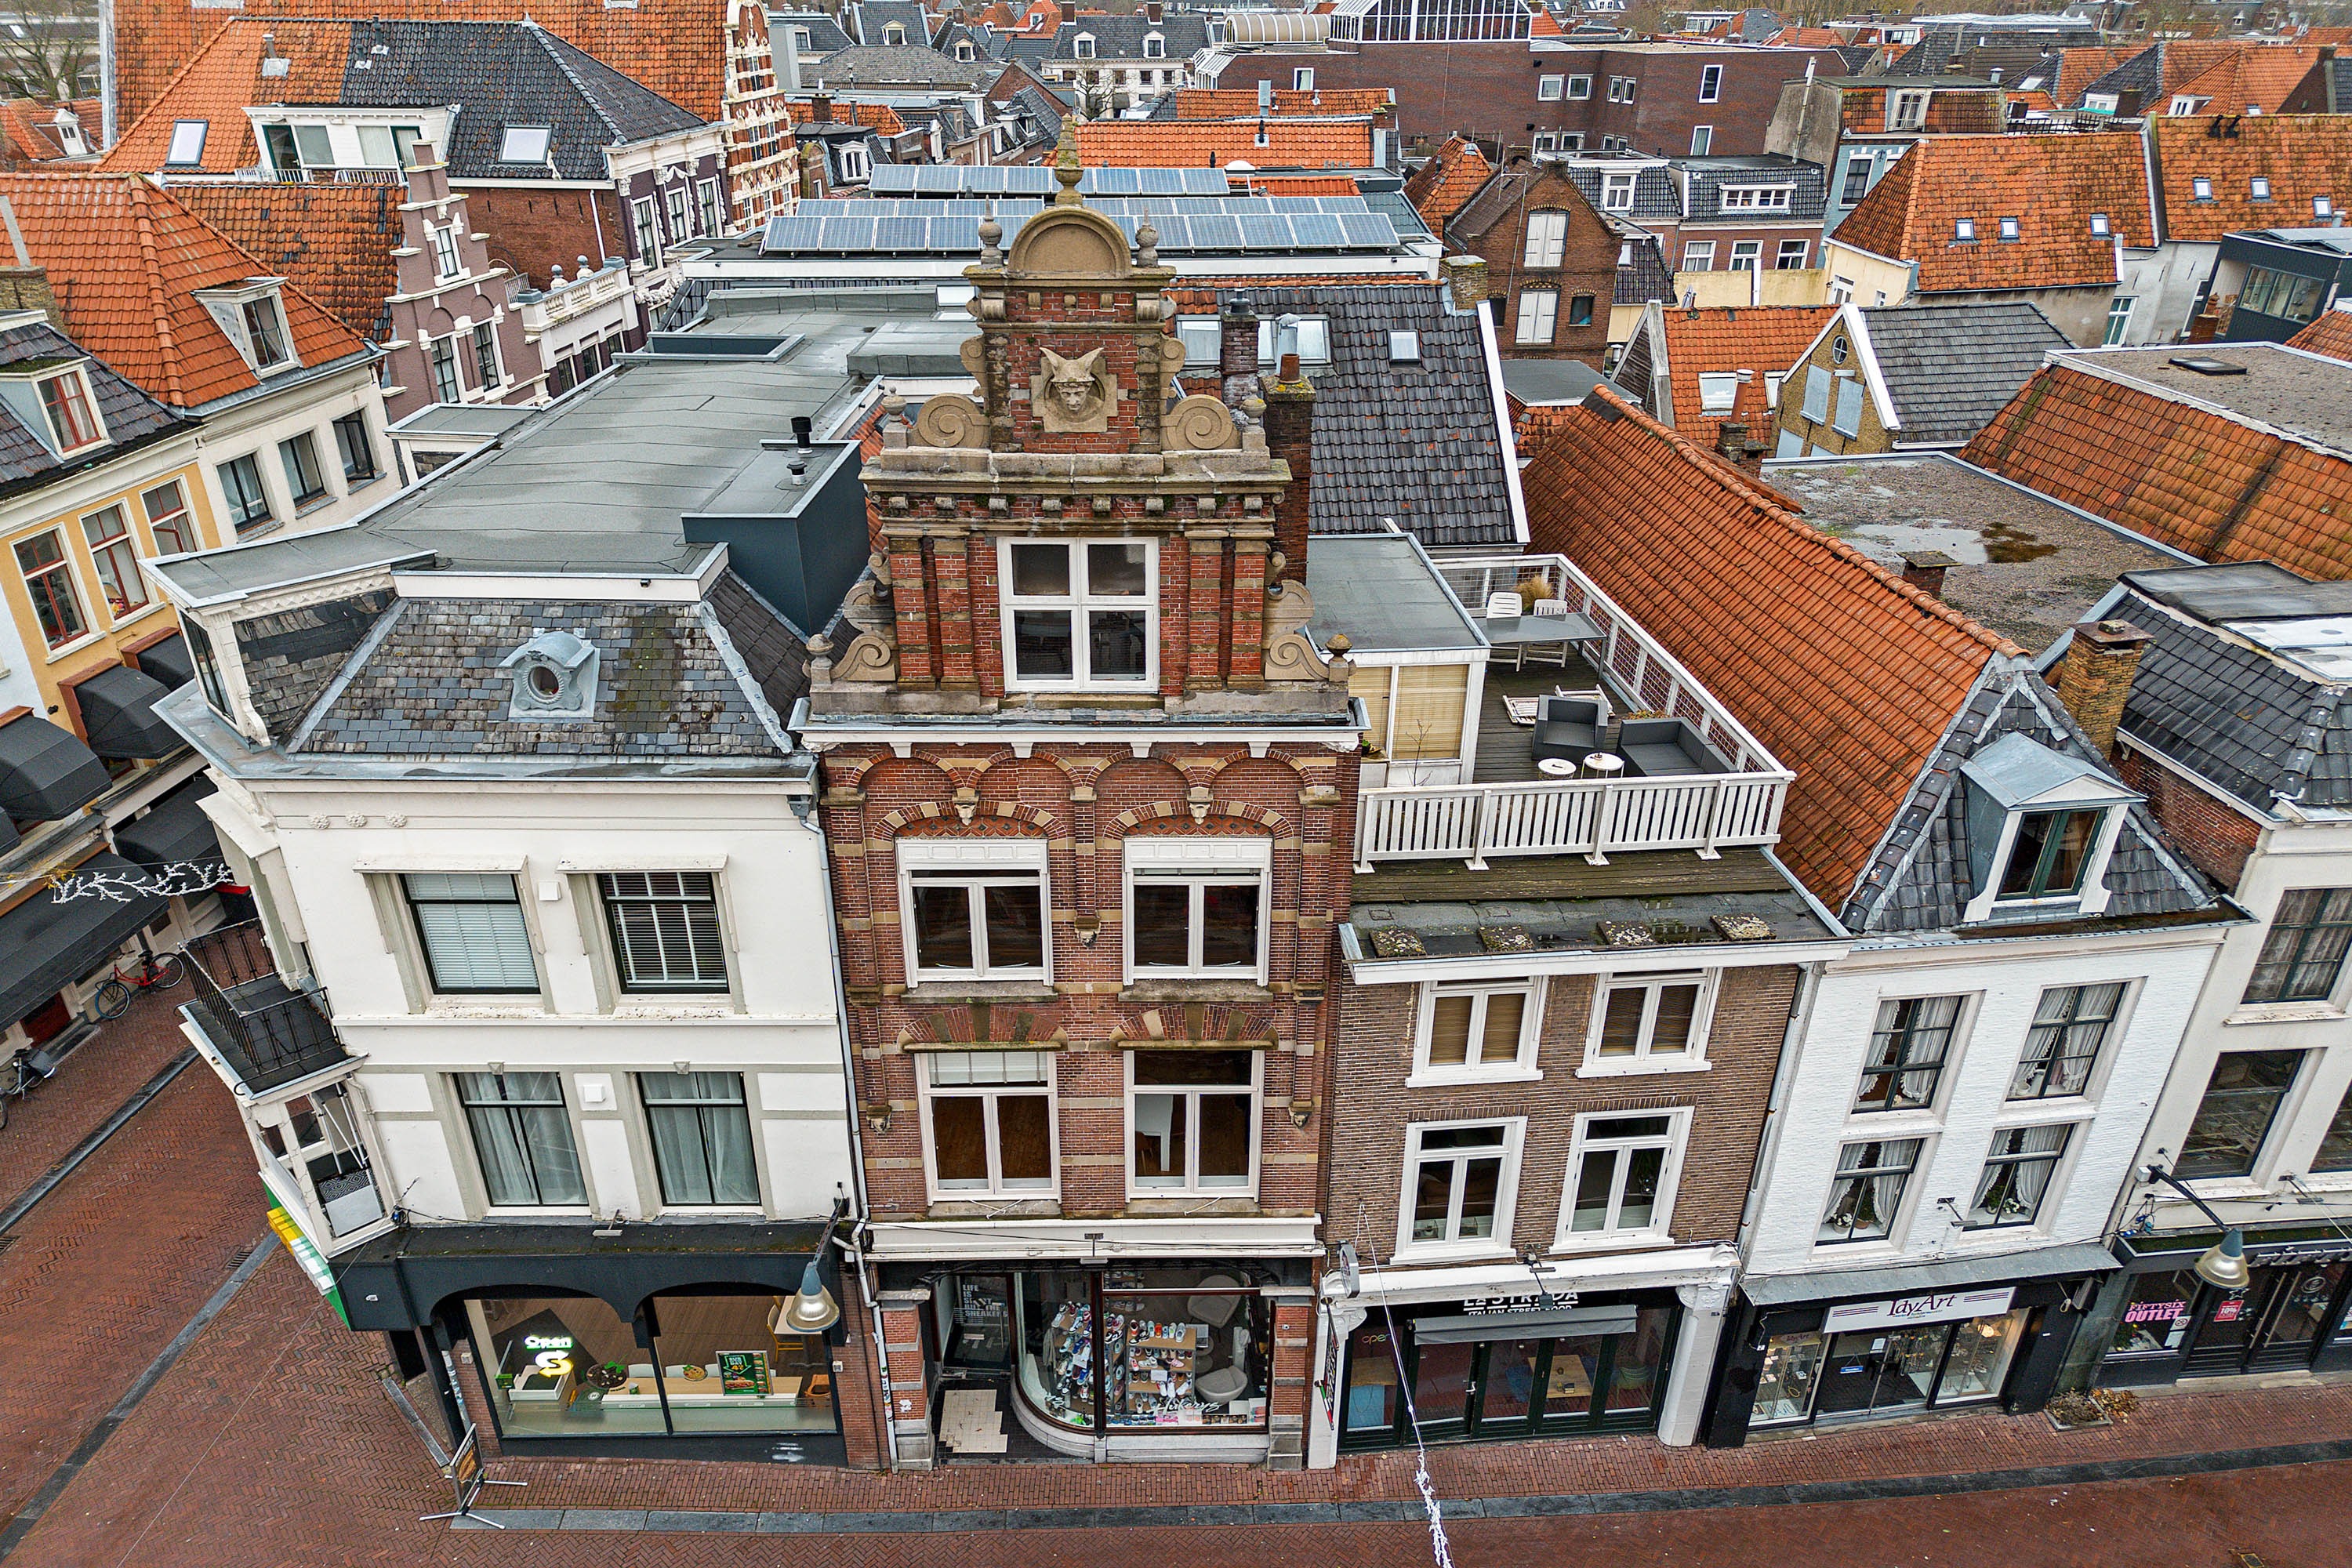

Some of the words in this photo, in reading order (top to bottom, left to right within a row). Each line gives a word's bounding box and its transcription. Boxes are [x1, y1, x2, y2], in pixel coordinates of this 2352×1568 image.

[1492, 1291, 1578, 1305] STRDA
[1887, 1294, 1957, 1316] IdyArt
[2125, 1308, 2183, 1323] OUTLET
[524, 1335, 573, 1349] Open
